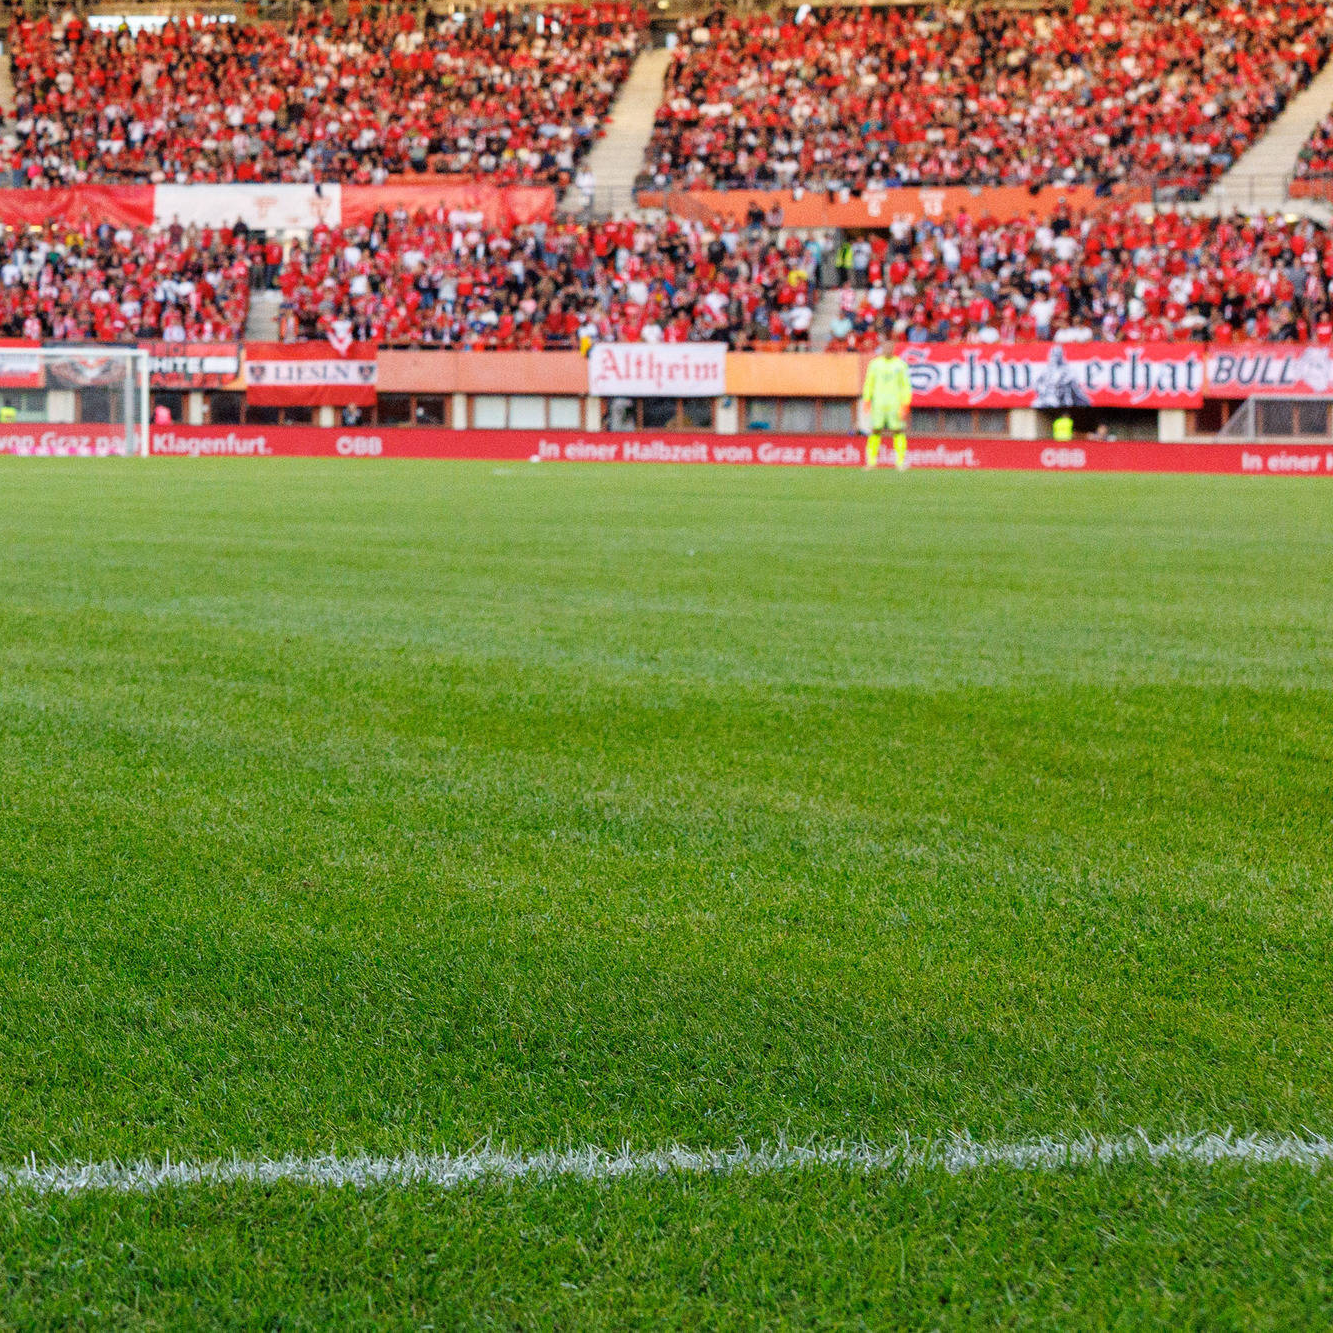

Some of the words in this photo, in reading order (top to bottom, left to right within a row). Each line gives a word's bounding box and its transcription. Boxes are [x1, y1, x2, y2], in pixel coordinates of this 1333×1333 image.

[1213, 354, 1294, 385] BULL
[153, 432, 273, 456] Klagenfurt.
[538, 439, 560, 459] In
[564, 439, 618, 461] einer
[622, 440, 708, 463] Halbzeit
[712, 446, 753, 462] von
[756, 442, 806, 464] Graz
[1241, 451, 1263, 470] In
[1267, 450, 1321, 471] einer
